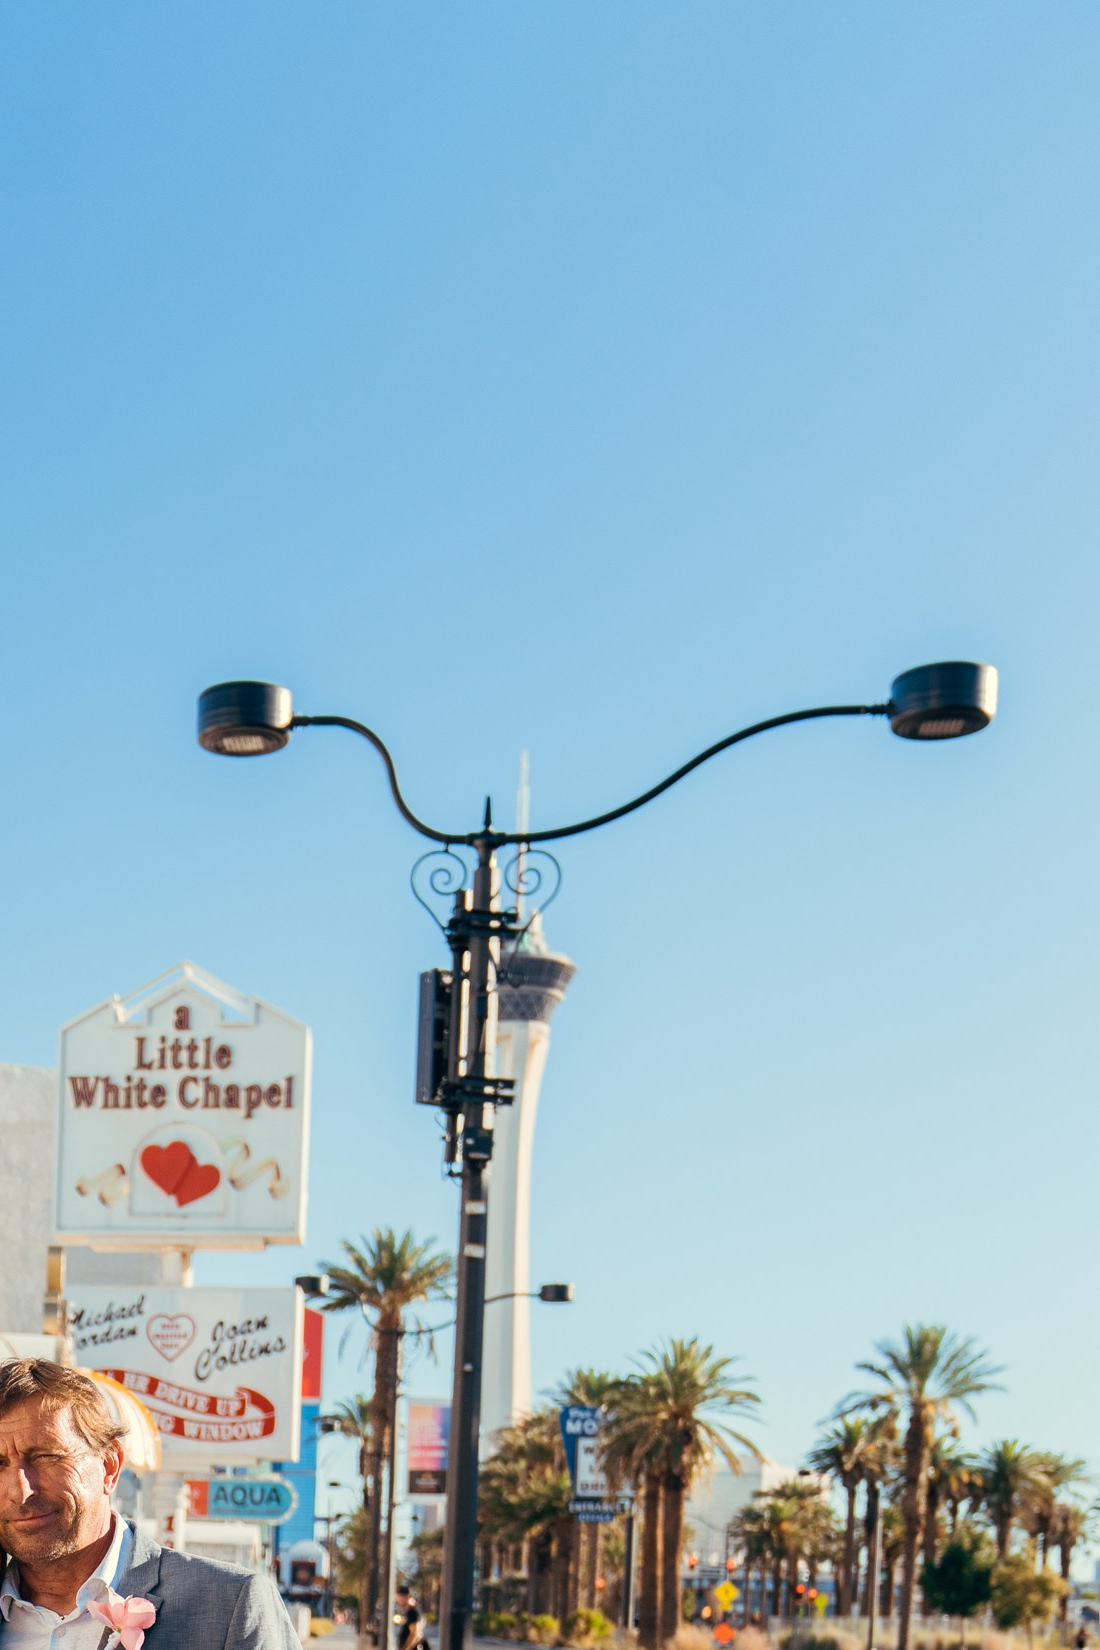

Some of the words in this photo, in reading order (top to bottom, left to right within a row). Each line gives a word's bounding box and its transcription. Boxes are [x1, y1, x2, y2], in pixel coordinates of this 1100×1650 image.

[174, 1005, 190, 1031] a
[134, 1036, 233, 1071] Little
[68, 1074, 167, 1110] White
[178, 1075, 295, 1120] Chapel
[212, 1315, 268, 1355] Joan
[194, 1337, 286, 1382] Collins
[154, 1381, 210, 1412] DRIVE
[217, 1398, 242, 1416] UP
[183, 1421, 264, 1440] WINDOW
[214, 1486, 281, 1506] AQUA
